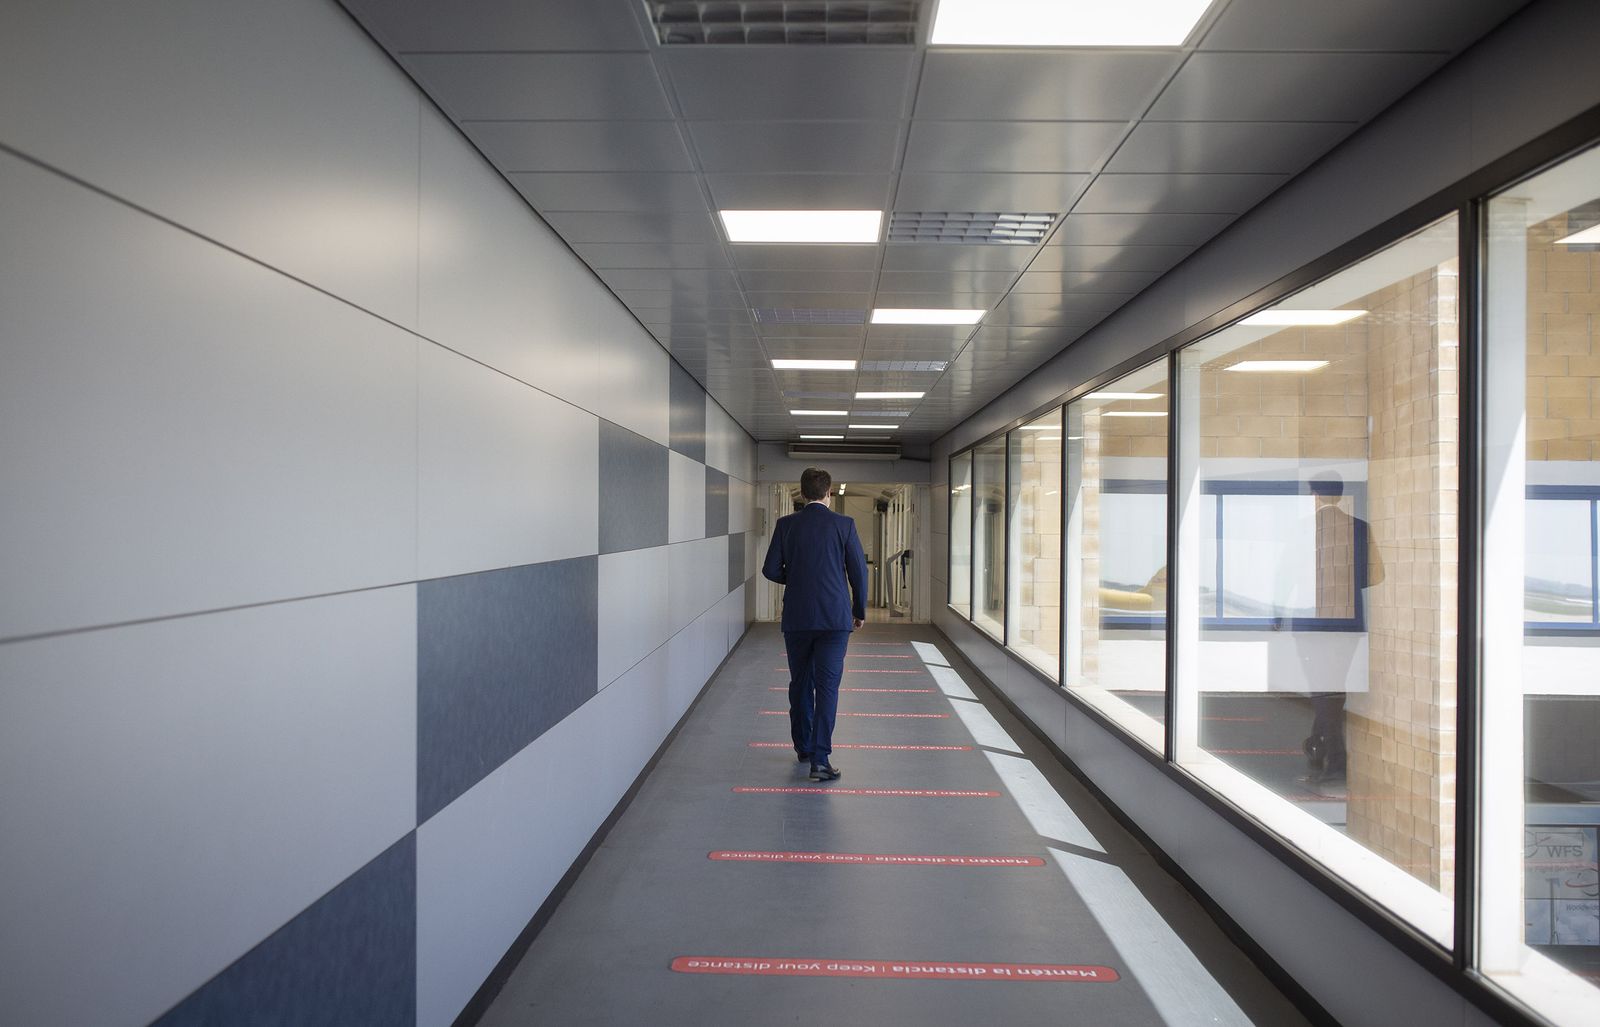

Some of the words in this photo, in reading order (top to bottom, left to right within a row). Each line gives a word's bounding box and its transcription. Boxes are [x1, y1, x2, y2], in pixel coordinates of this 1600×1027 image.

[1546, 846, 1583, 858] WFS
[687, 961, 771, 970] distance
[827, 964, 876, 973] Keep
[892, 965, 986, 975] distancia
[993, 967, 1011, 976] la
[1017, 968, 1097, 977] Mantén
